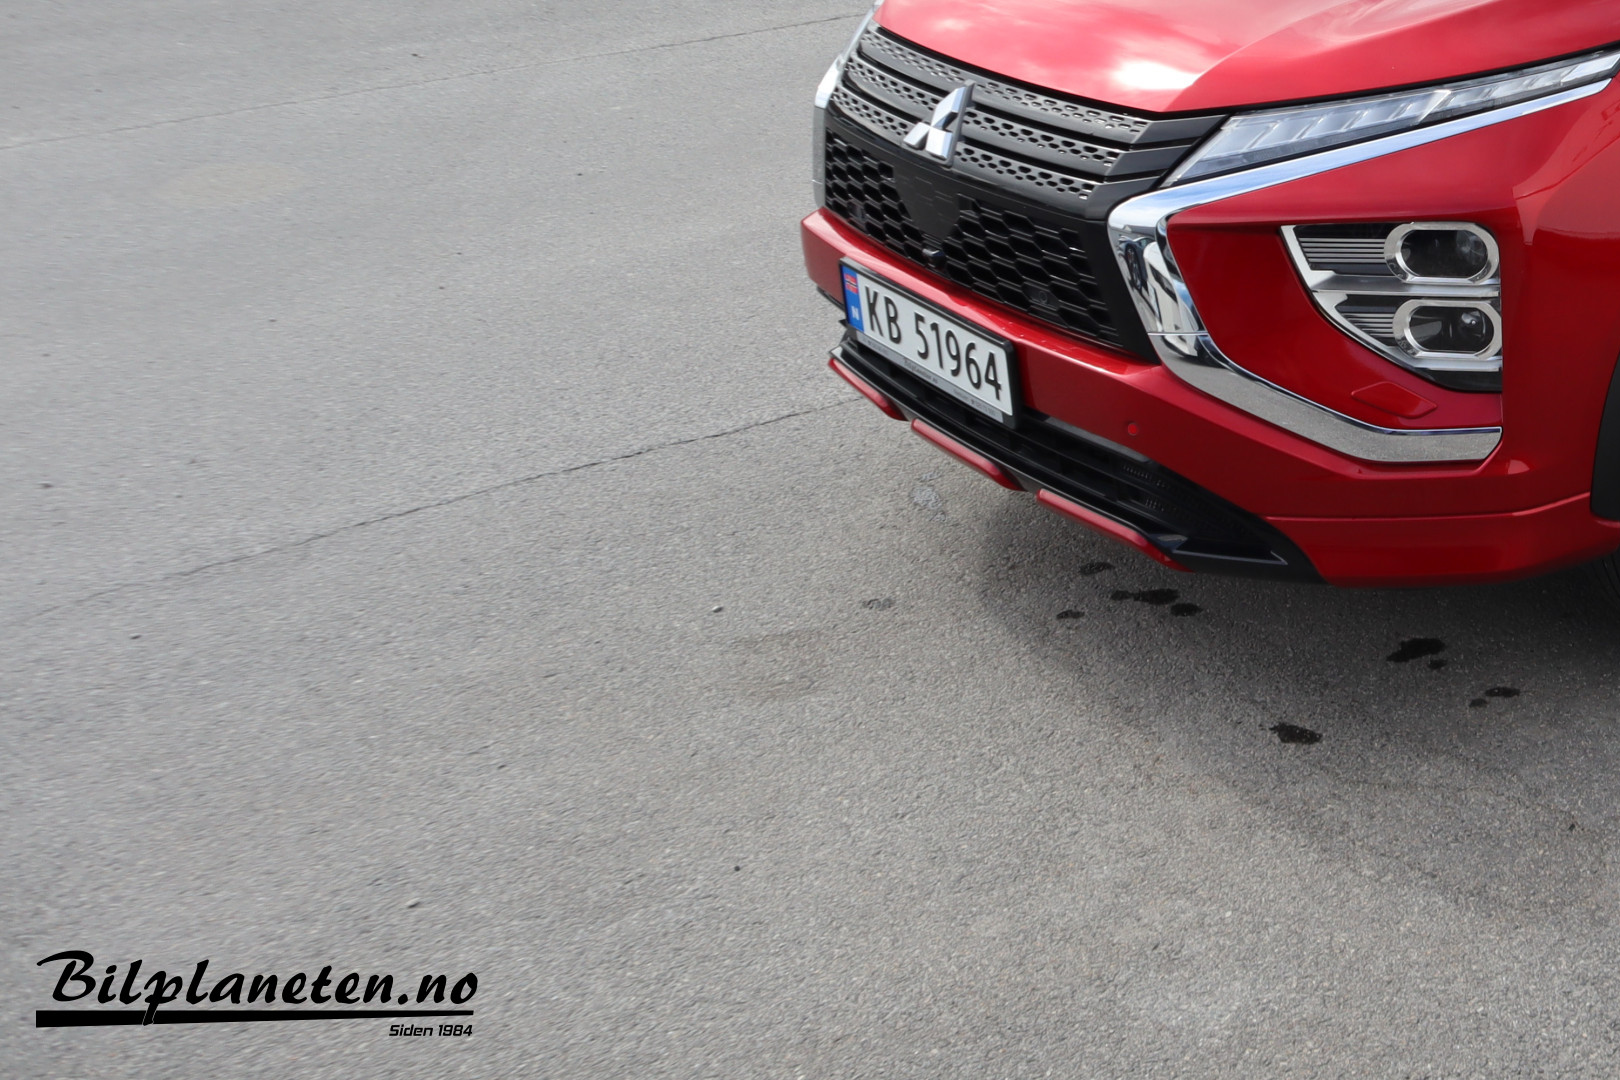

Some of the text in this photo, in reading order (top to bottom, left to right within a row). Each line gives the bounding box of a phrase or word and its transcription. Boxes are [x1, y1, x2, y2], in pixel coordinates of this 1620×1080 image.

[851, 305, 860, 320] N
[864, 285, 1002, 401] KB 51964
